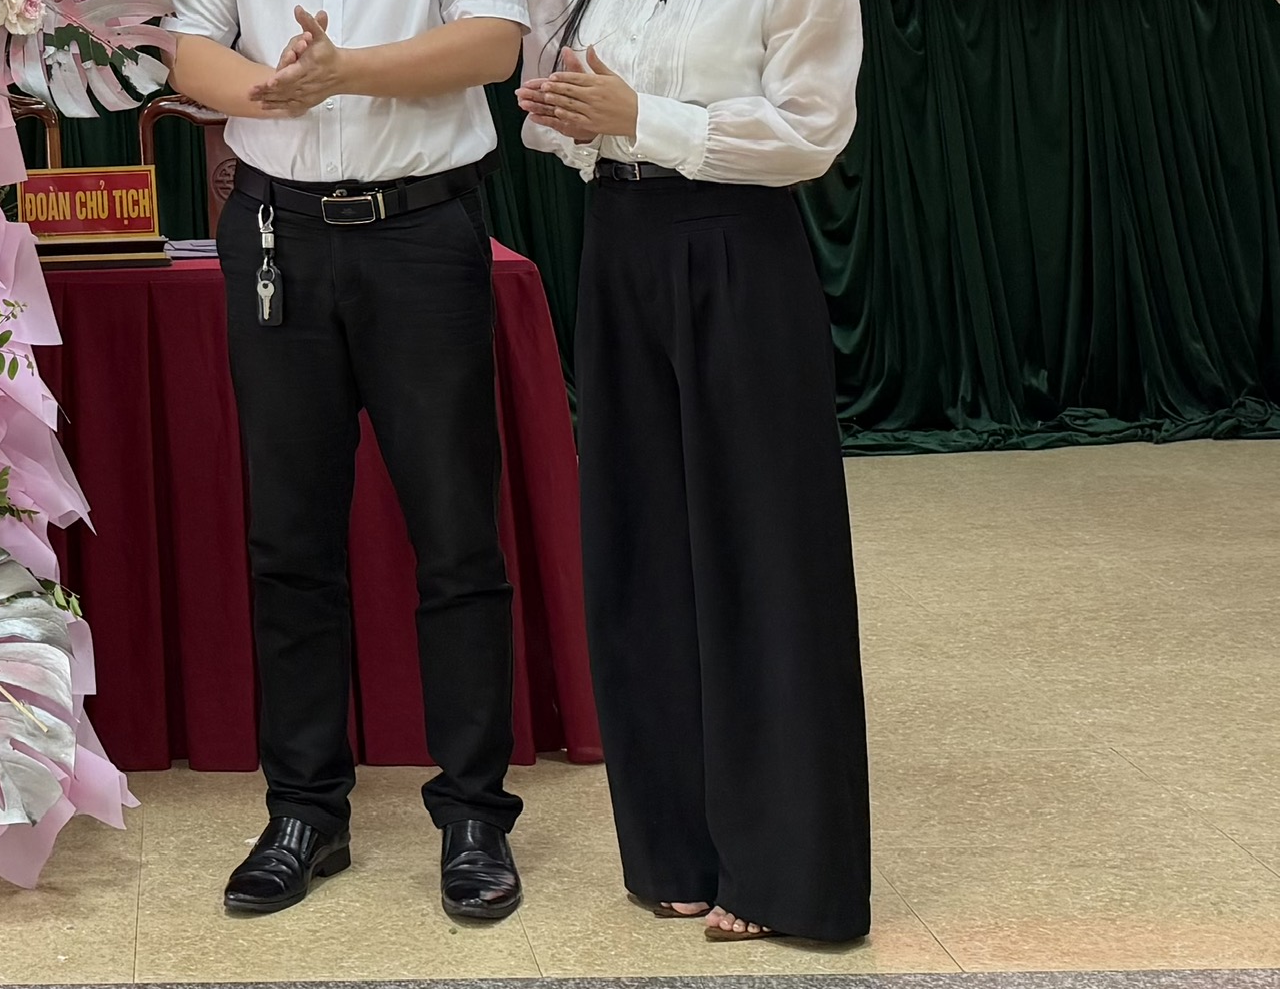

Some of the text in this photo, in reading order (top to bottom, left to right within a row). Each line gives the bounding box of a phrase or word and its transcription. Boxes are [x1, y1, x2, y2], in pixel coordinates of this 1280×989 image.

[25, 180, 151, 225] ĐOÀN CHỦ TỊCH
